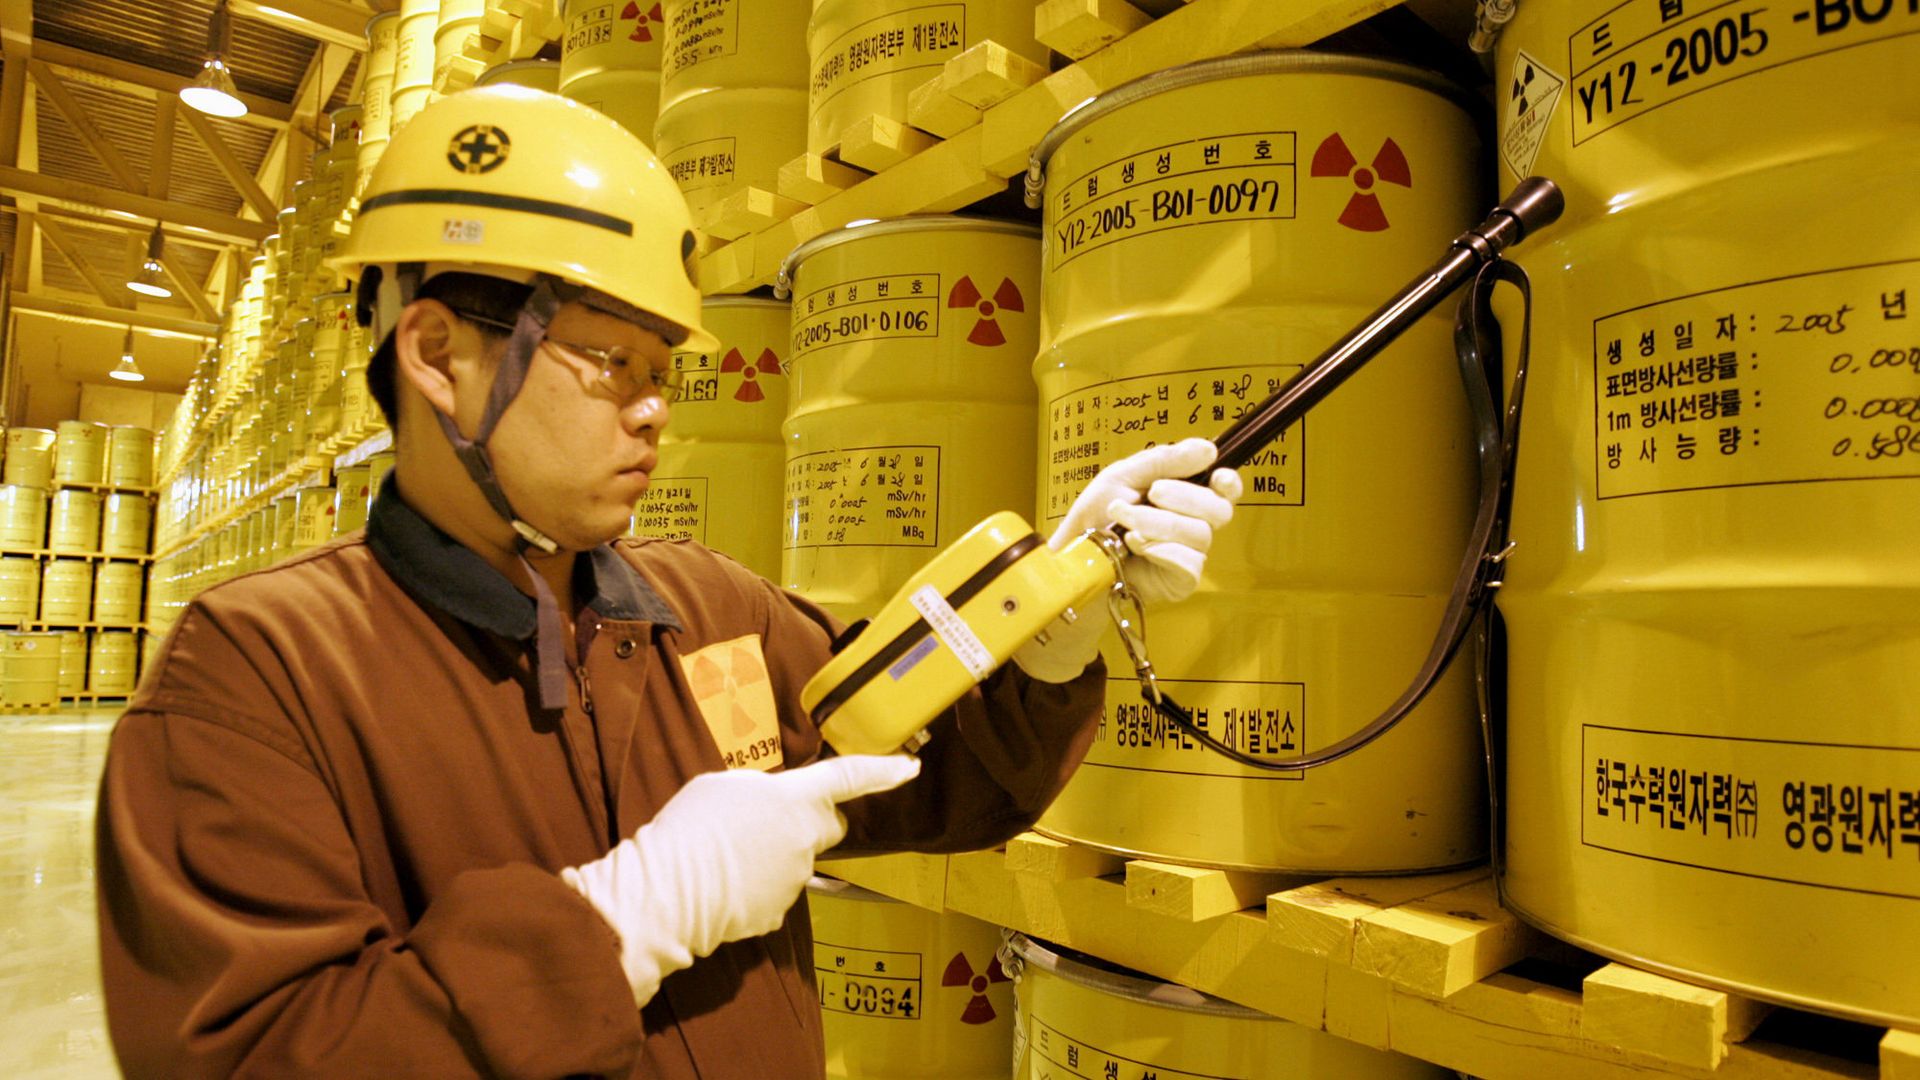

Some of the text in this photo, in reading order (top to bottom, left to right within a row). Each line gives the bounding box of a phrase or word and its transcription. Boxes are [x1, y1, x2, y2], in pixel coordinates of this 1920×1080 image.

[913, 20, 960, 52] 제1발전소
[1087, 175, 1098, 197] 럼
[1121, 162, 1135, 184] 생
[1156, 152, 1171, 174] 성
[1204, 144, 1220, 165] 번
[1254, 140, 1272, 160] 호
[1775, 304, 1854, 334] 2005
[1880, 289, 1906, 320] 년
[1606, 352, 1738, 398] 표면방사선량률
[1112, 393, 1152, 408] 2005
[1157, 385, 1168, 401] 년
[1187, 382, 1198, 400] 6
[1212, 380, 1224, 396] 월
[1230, 374, 1252, 400] 28
[1112, 416, 1155, 435] 2005
[1157, 409, 1168, 425] 년
[1189, 404, 1202, 425] 6
[1608, 410, 1631, 432] 1m
[1641, 388, 1742, 428] 방사선량률
[887, 490, 926, 502] mSv/hr
[1254, 476, 1285, 497] MBq
[674, 502, 698, 513] mSv/hr
[674, 517, 698, 527] mSv/hr
[886, 507, 926, 519] mSv/hr
[902, 526, 924, 540] MBq
[1223, 707, 1295, 754] 제1발전소
